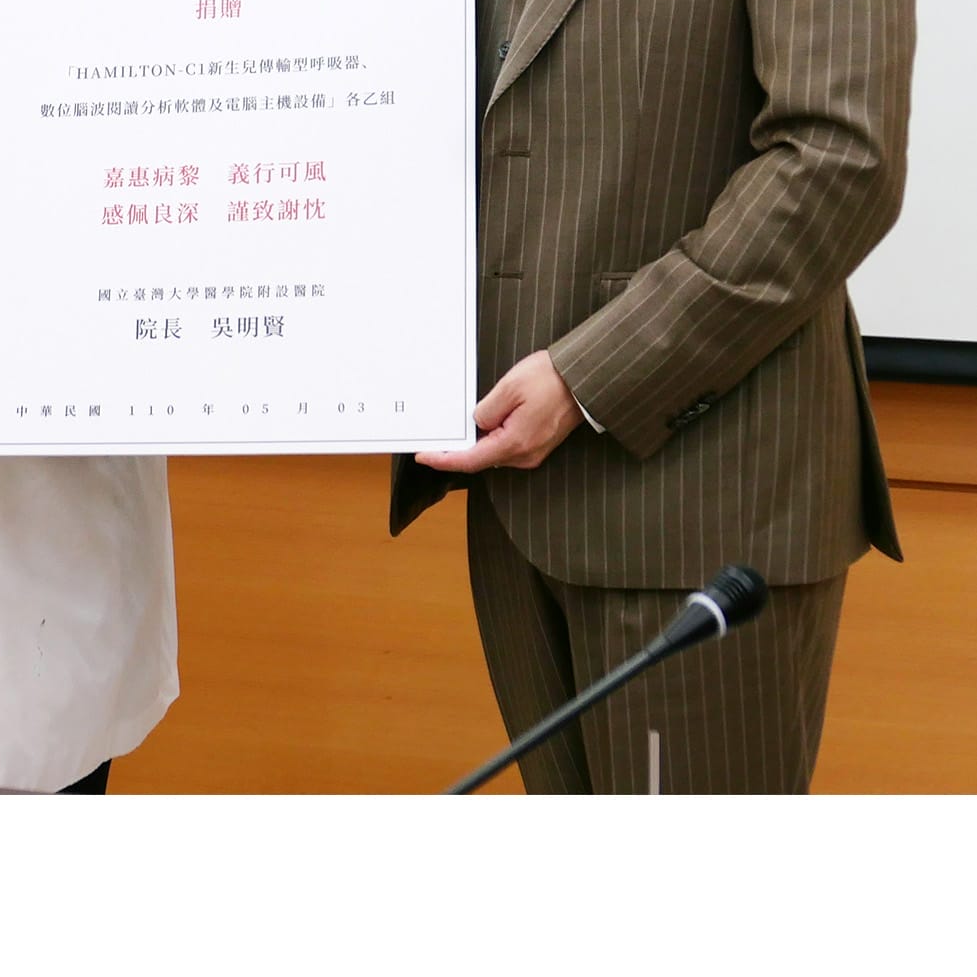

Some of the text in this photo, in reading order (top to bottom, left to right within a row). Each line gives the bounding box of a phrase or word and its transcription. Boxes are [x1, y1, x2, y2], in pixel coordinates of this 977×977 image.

[103, 160, 327, 189] 嘉惠病黎 義行可風
[102, 198, 326, 226] 感佩良深 謹致謝忱
[98, 283, 325, 302] 國立臺灣大學醫學院附設醫院
[135, 315, 285, 340] 院長 吳明賢
[15, 400, 405, 417] 中華民國 110 年 05 月 03 日
